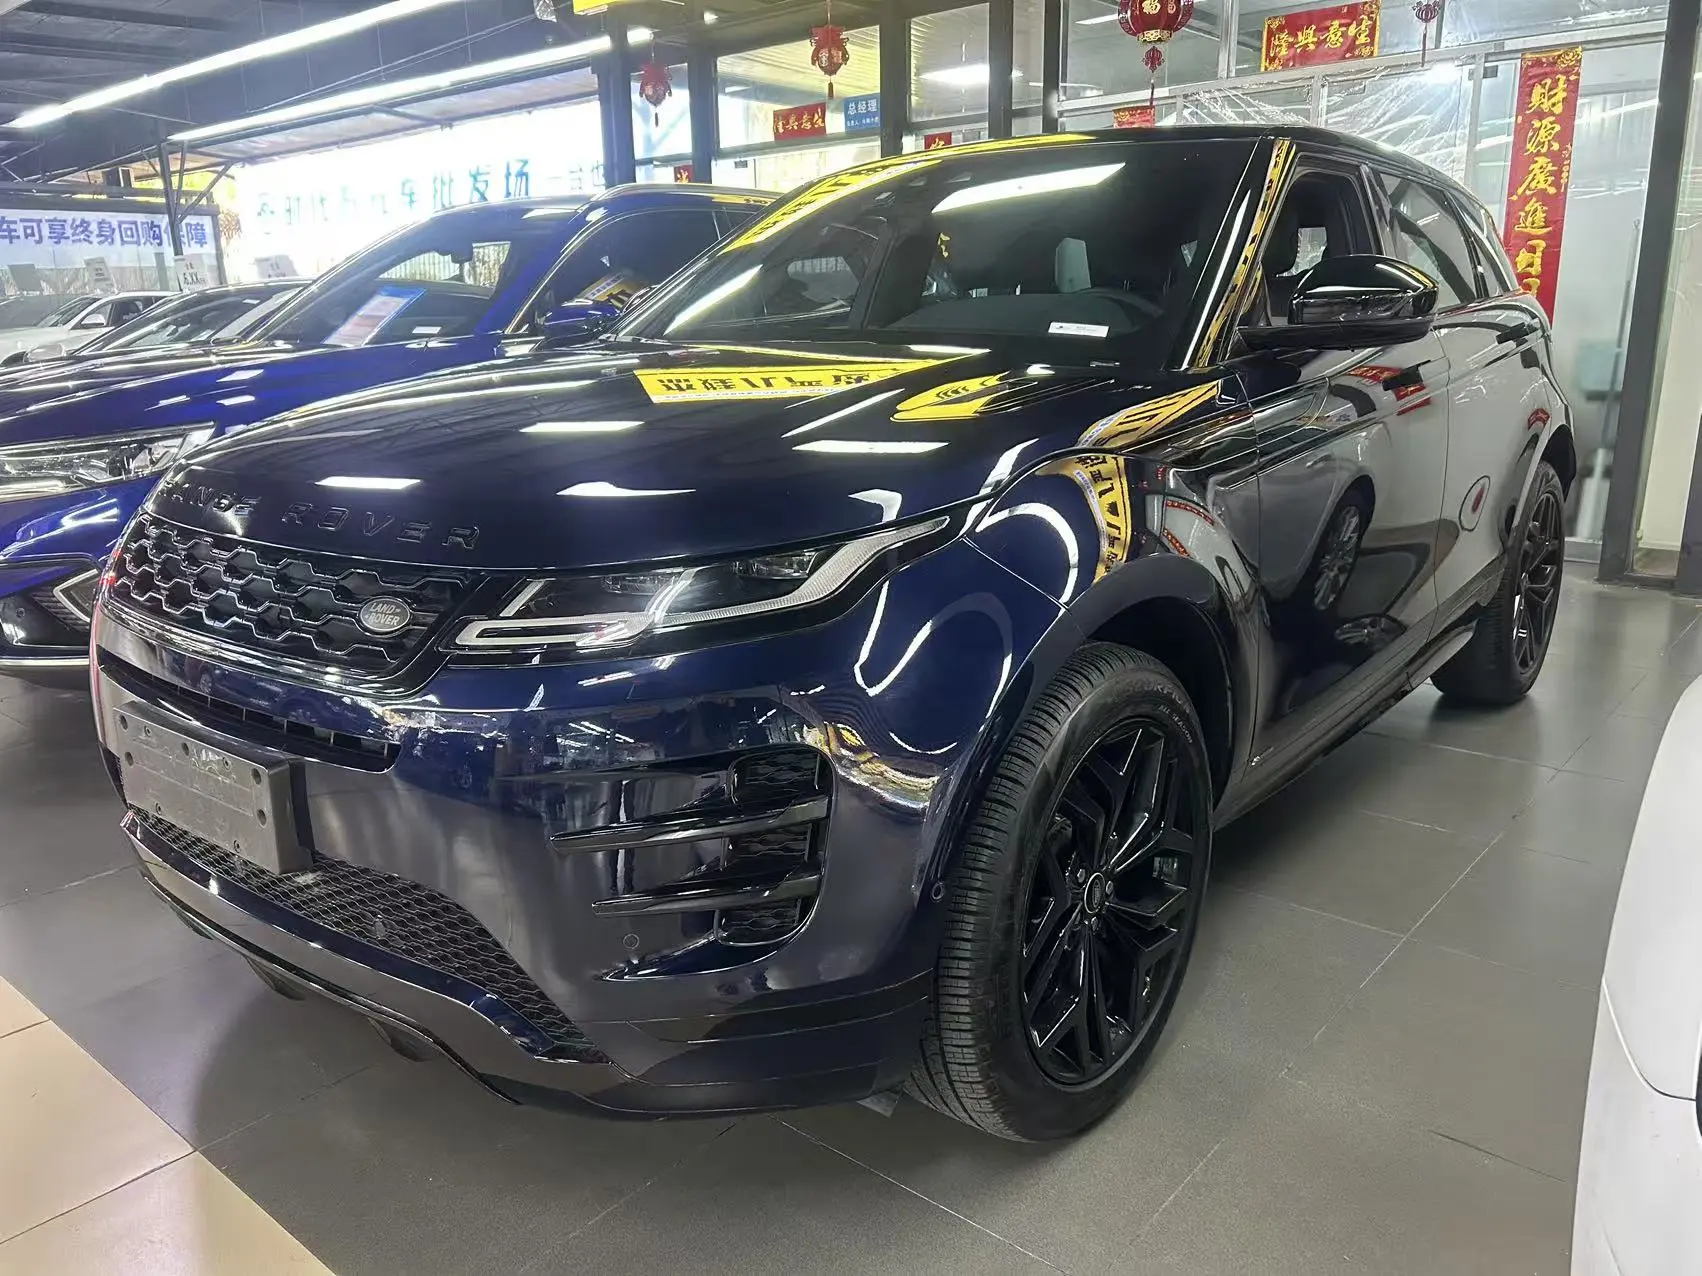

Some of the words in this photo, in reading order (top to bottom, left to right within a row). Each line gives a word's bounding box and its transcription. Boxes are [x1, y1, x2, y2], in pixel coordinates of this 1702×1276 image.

[847, 98, 878, 115] 总经理
[281, 502, 480, 550] ROVER
[369, 602, 397, 614] LAND
[367, 612, 400, 626] ROVER
